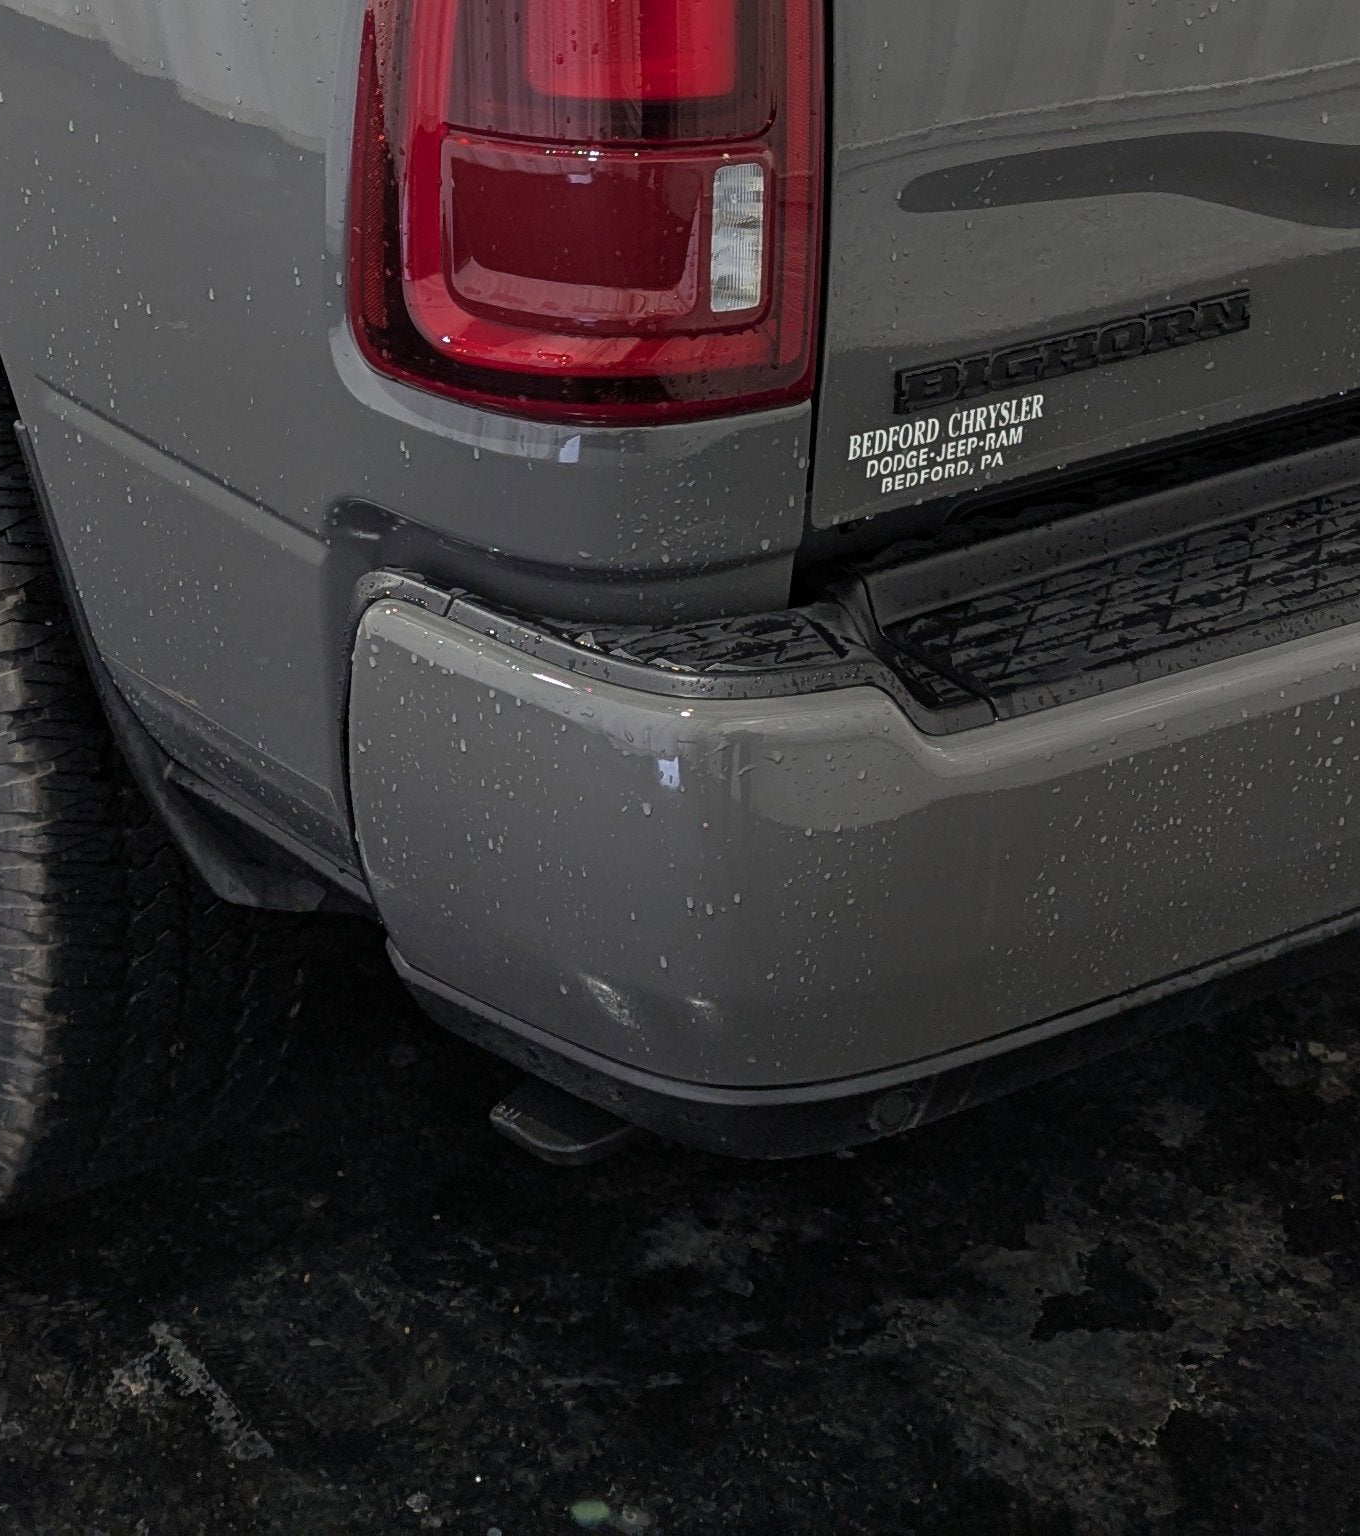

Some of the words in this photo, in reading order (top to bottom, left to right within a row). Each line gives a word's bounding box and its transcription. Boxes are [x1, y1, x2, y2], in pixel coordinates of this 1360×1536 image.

[847, 417, 940, 461] BEDFORD
[948, 394, 1044, 439] CHRYSLER
[880, 463, 974, 494] BEDFORD,
[980, 452, 1004, 470] PA
